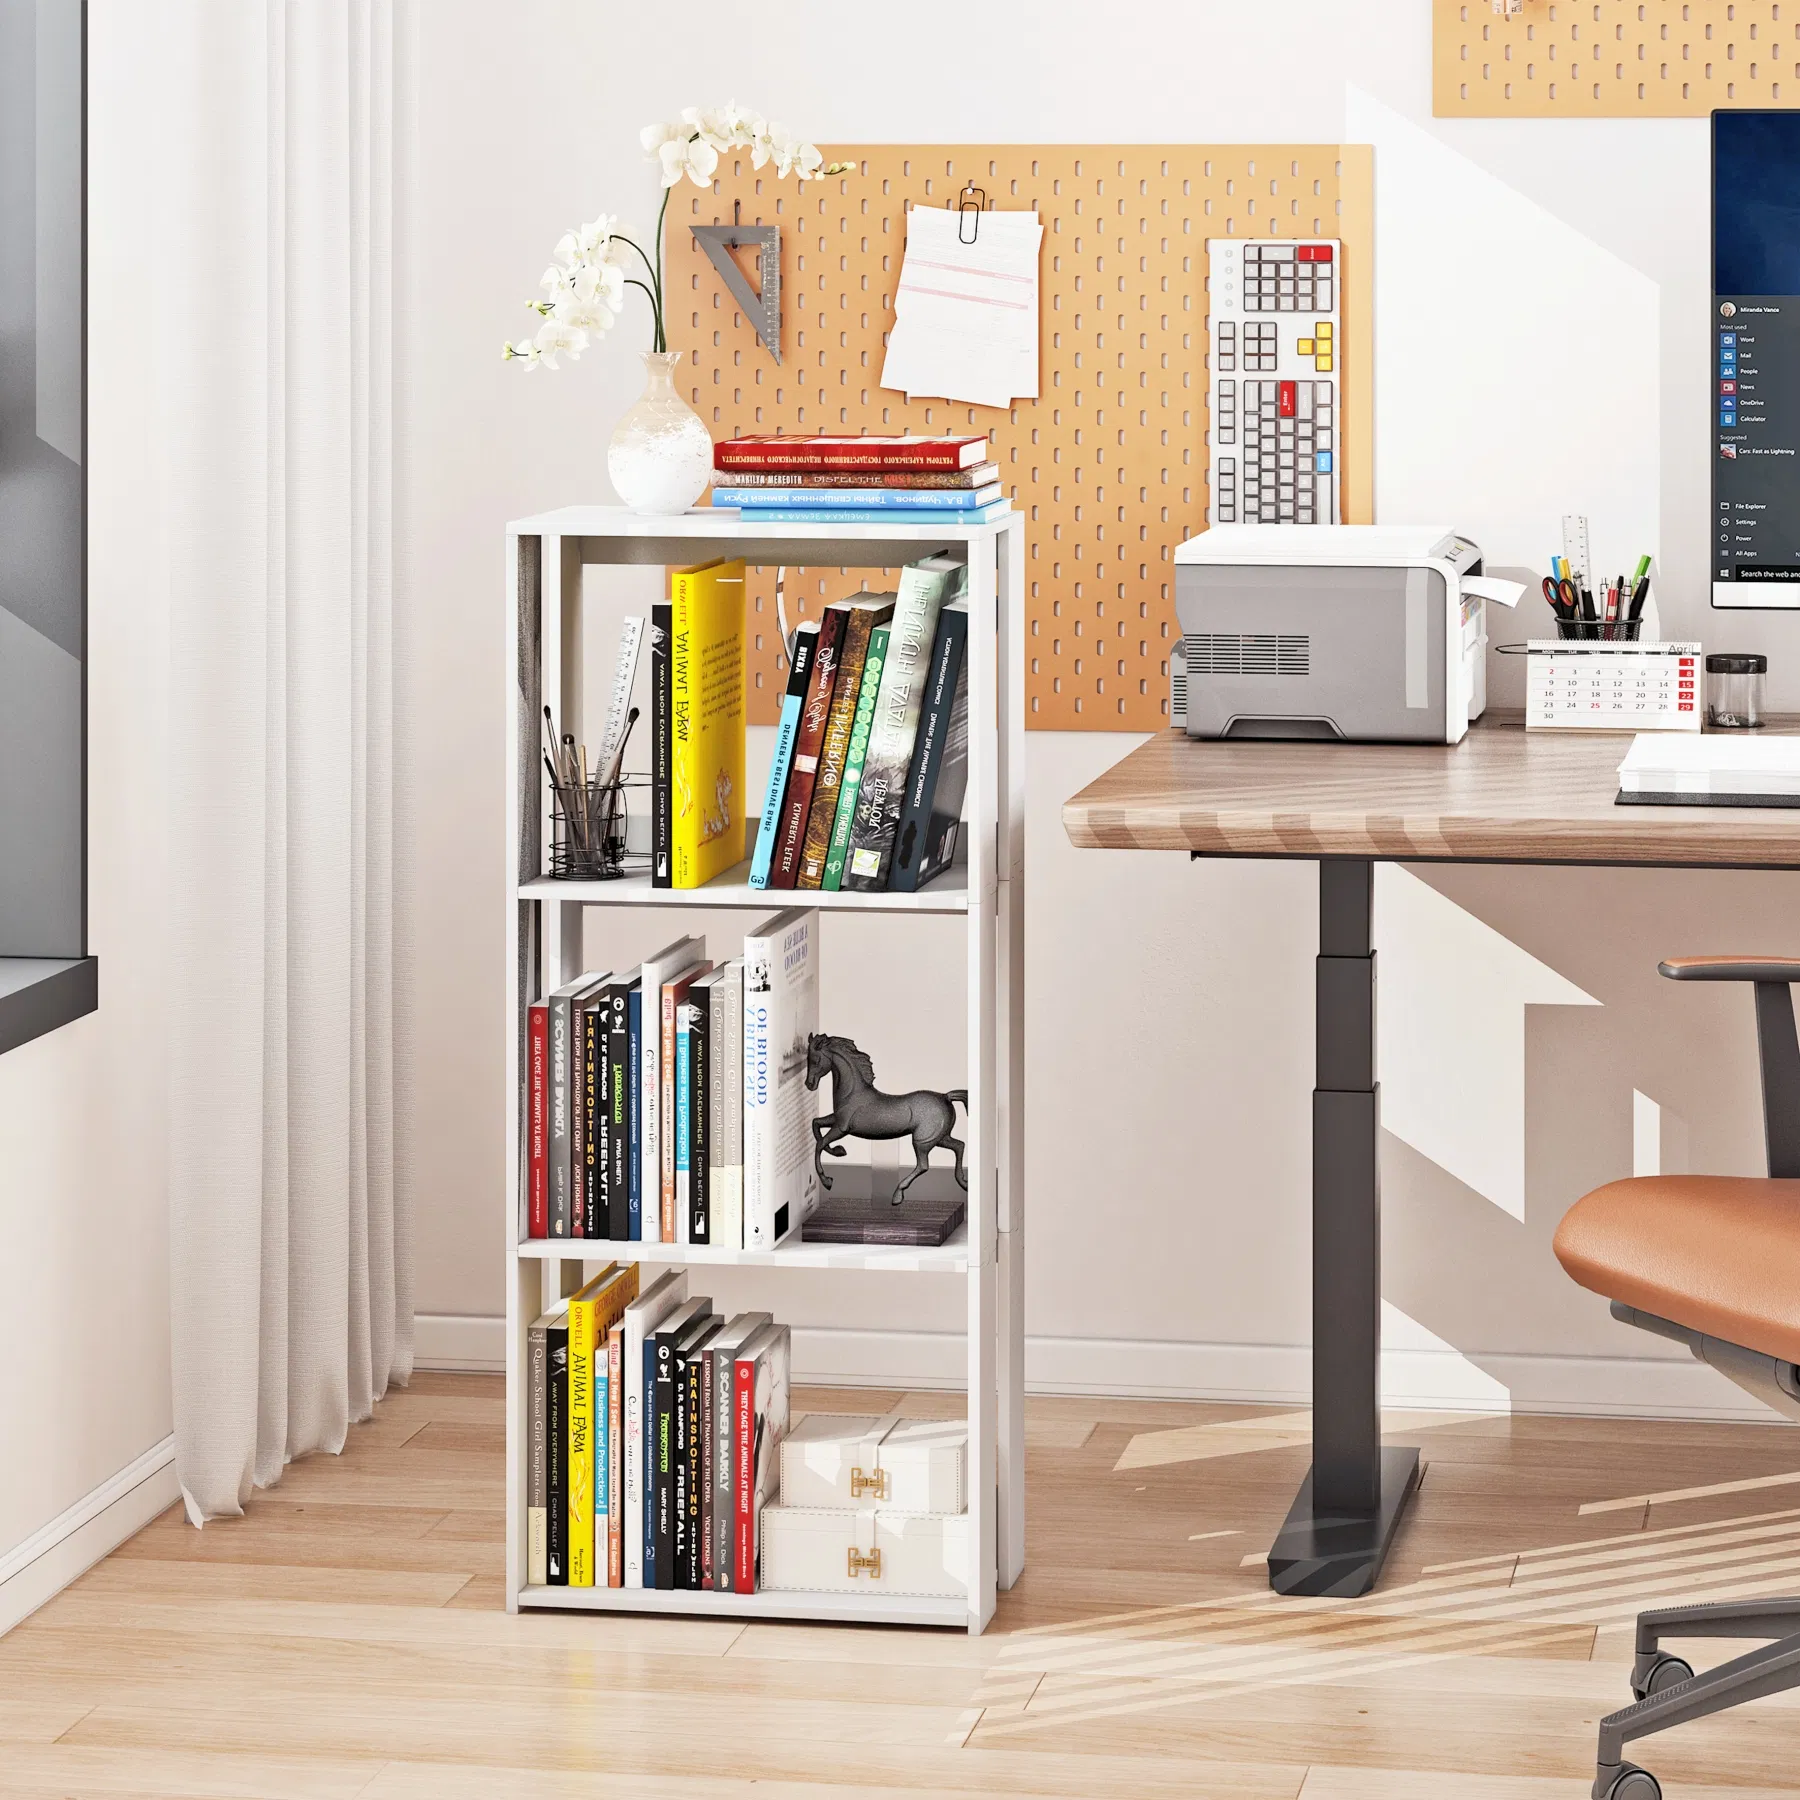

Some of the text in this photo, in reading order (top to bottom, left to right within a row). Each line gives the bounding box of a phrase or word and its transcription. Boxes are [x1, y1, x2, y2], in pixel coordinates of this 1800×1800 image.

[1770, 448, 1795, 456] Lightning
[768, 475, 802, 484] MEREDITH
[724, 493, 748, 503] Руси
[751, 494, 789, 502] камней
[854, 495, 887, 504] Тайны
[1741, 570, 1762, 578] Search
[1668, 645, 1694, 654] April
[574, 1307, 583, 1348] ORWELL
[610, 1344, 619, 1365] Blind
[573, 1352, 587, 1454] ANIMAL FARM
[532, 1348, 543, 1507] Quaker School Girl Samplers from
[719, 1354, 730, 1491] A SCANNER DARKLY
[597, 1390, 606, 1498] Business and Production
[689, 1366, 698, 1516] TRAINSPOTTING
[704, 1457, 711, 1465] OF
[740, 1390, 749, 1513] THEY CAGE THE ANIMALS AT NIGHT
[660, 1487, 668, 1535] MARY SHELLY
[677, 1465, 685, 1555] FREEFALL
[719, 1519, 727, 1538] Philip
[719, 1549, 727, 1565] Dick
